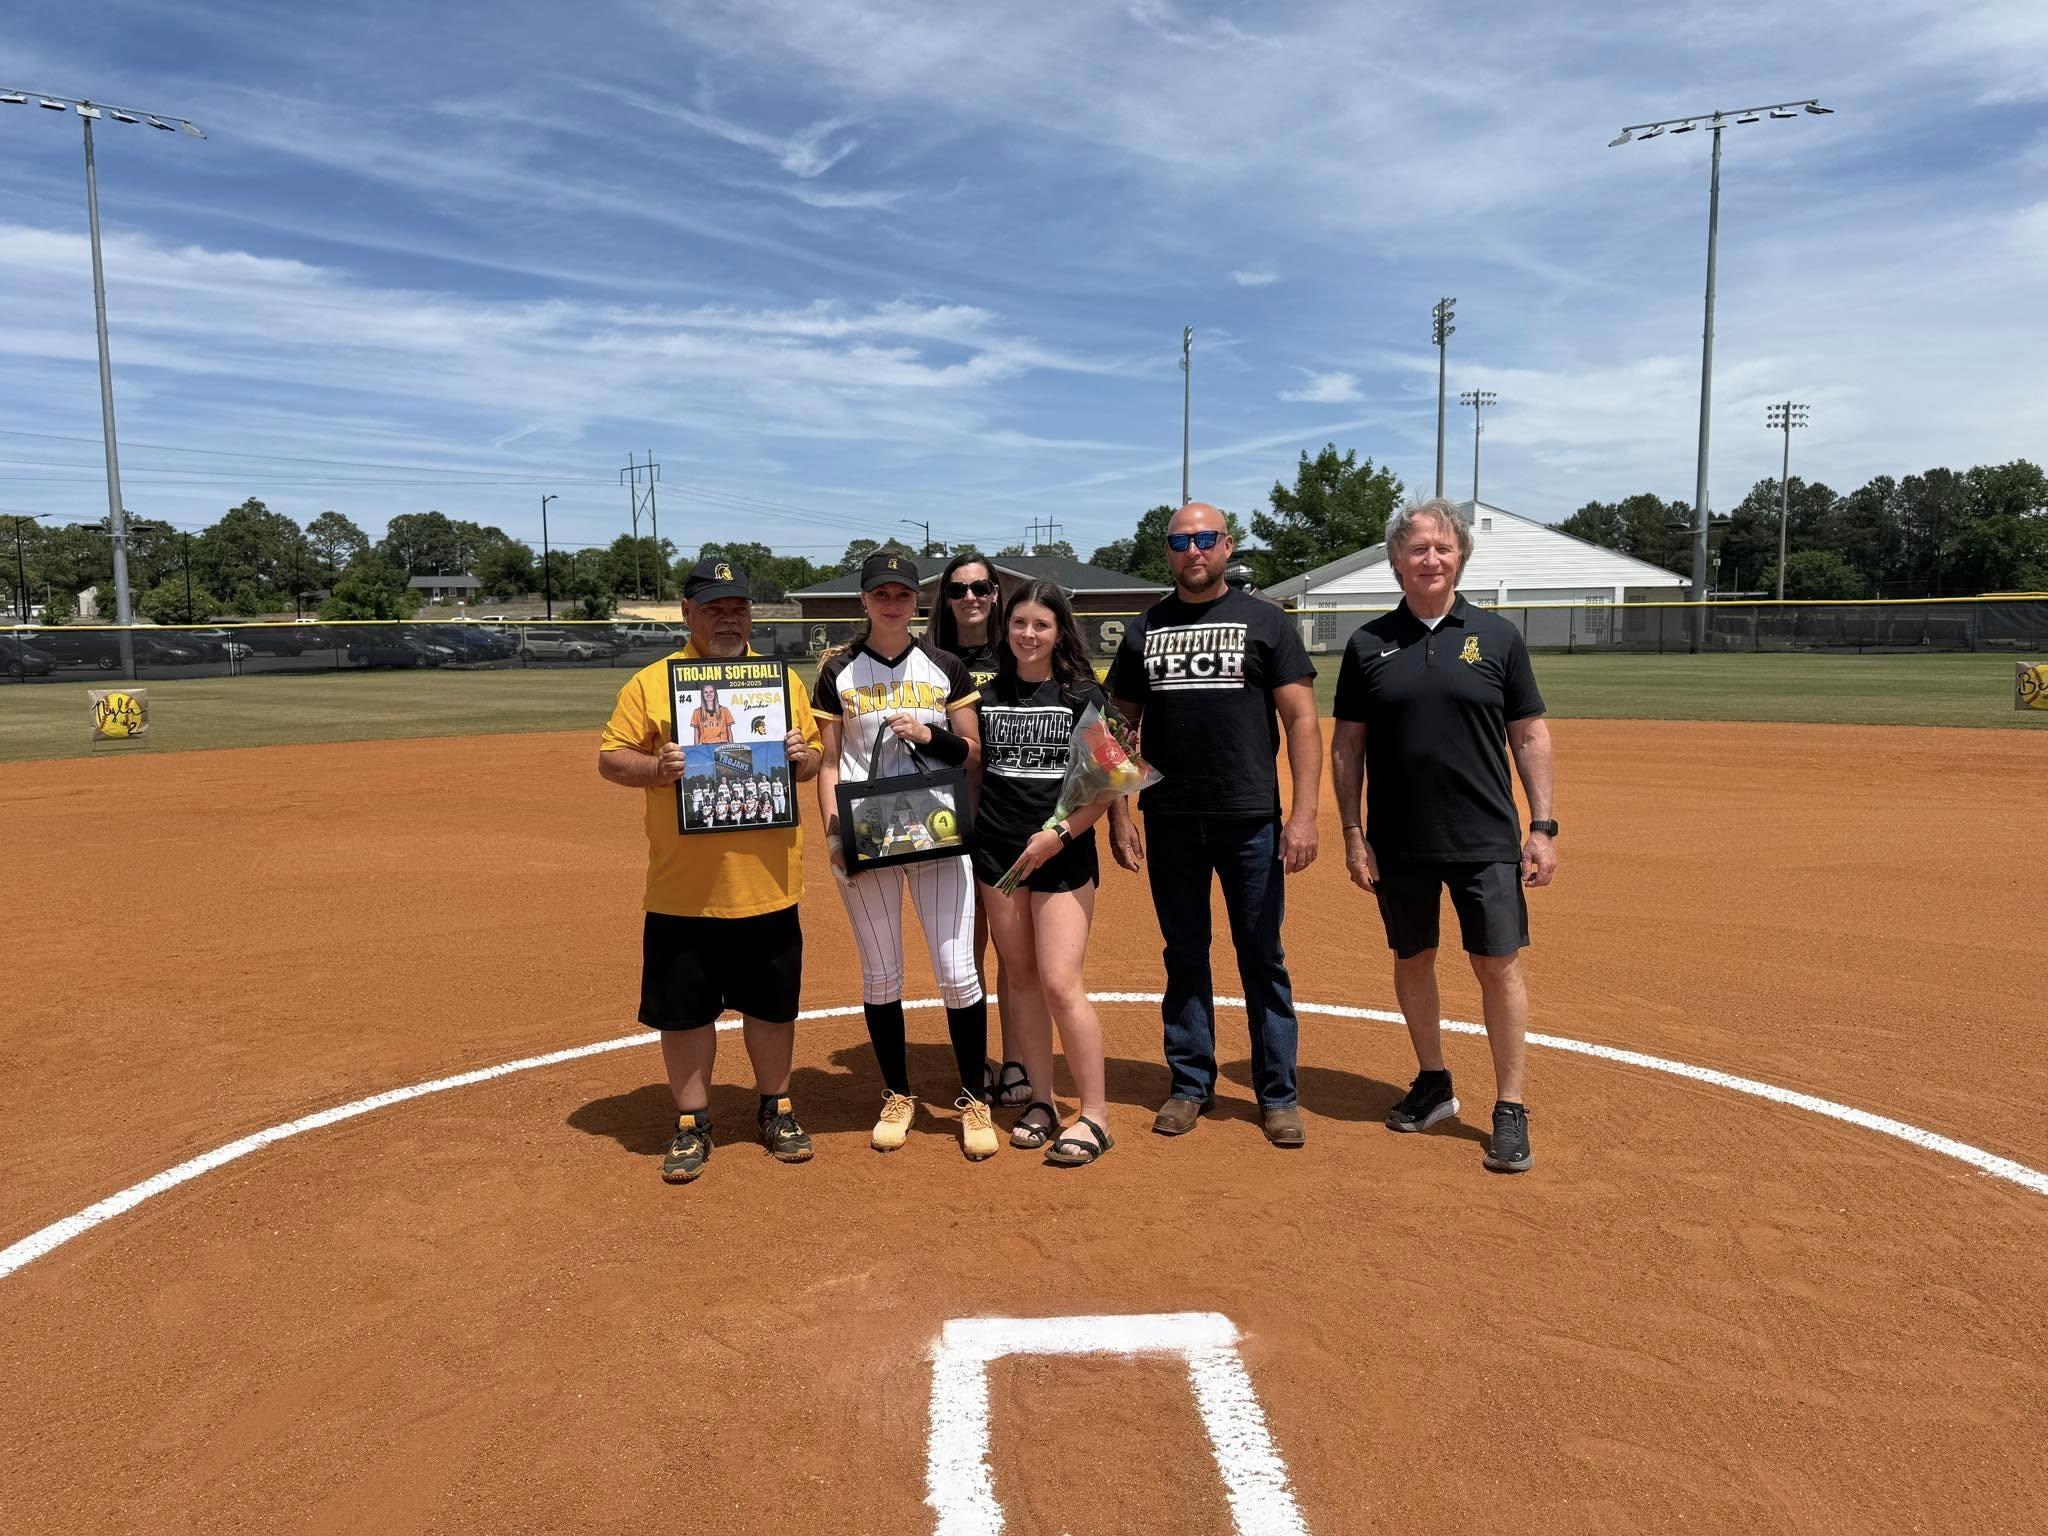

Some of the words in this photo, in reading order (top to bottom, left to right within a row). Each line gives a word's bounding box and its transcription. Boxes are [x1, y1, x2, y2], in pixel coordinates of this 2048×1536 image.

[1143, 628, 1247, 657] FAYETTEVILLE
[677, 666, 722, 682] TROJAN
[725, 664, 780, 680] SOFTBALL
[1143, 652, 1245, 681] TECH
[729, 680, 762, 688] 2024-2025
[2018, 671, 2048, 695] Be
[678, 694, 692, 704] #4
[731, 692, 782, 705] ALYSSA
[841, 680, 947, 720] TROJANS
[981, 711, 1073, 747] AYETTEVILLE
[719, 754, 750, 772] TROJANS
[938, 815, 948, 828] 4
